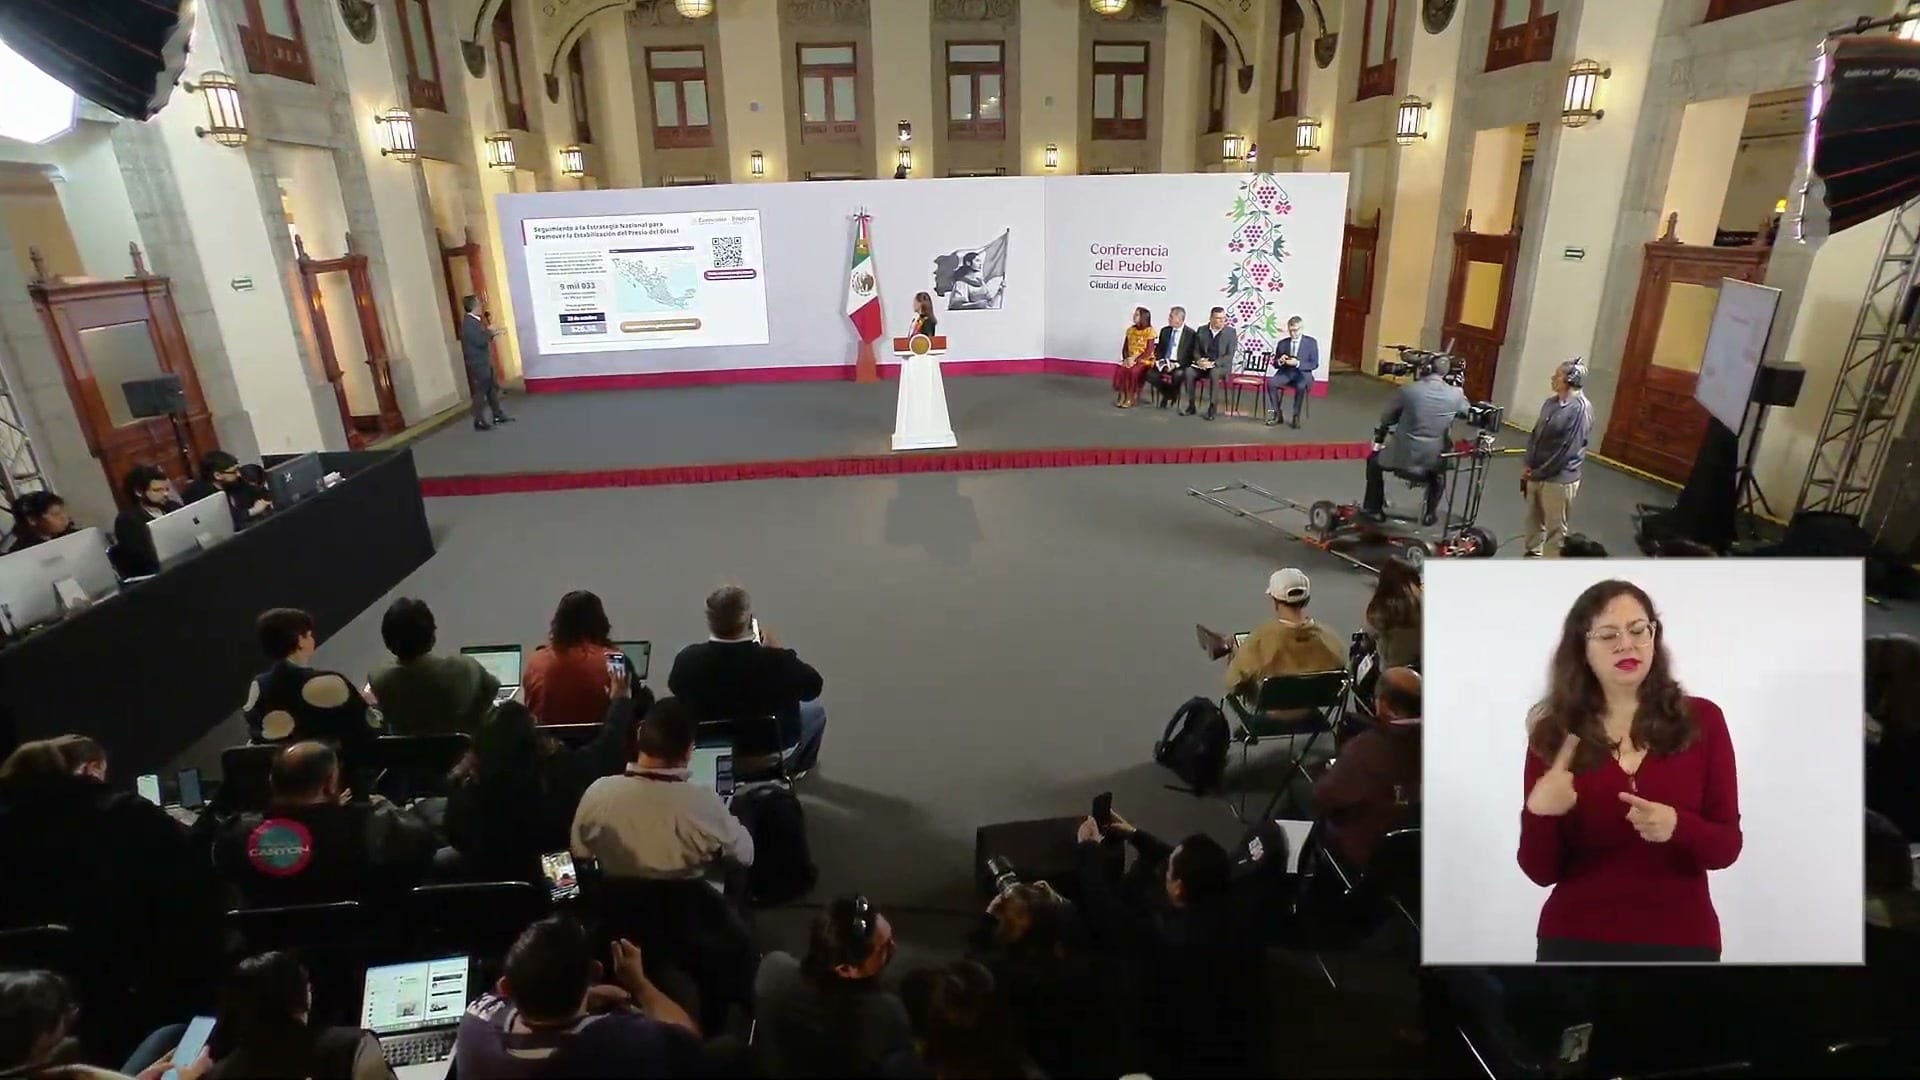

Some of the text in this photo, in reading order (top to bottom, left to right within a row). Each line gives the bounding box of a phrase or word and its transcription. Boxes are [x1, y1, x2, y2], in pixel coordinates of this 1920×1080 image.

[1090, 243, 1169, 257] Conferencia
[1095, 259, 1162, 272] del Pueblo
[567, 282, 580, 290] mil
[1089, 280, 1167, 291] Ciudad de México
